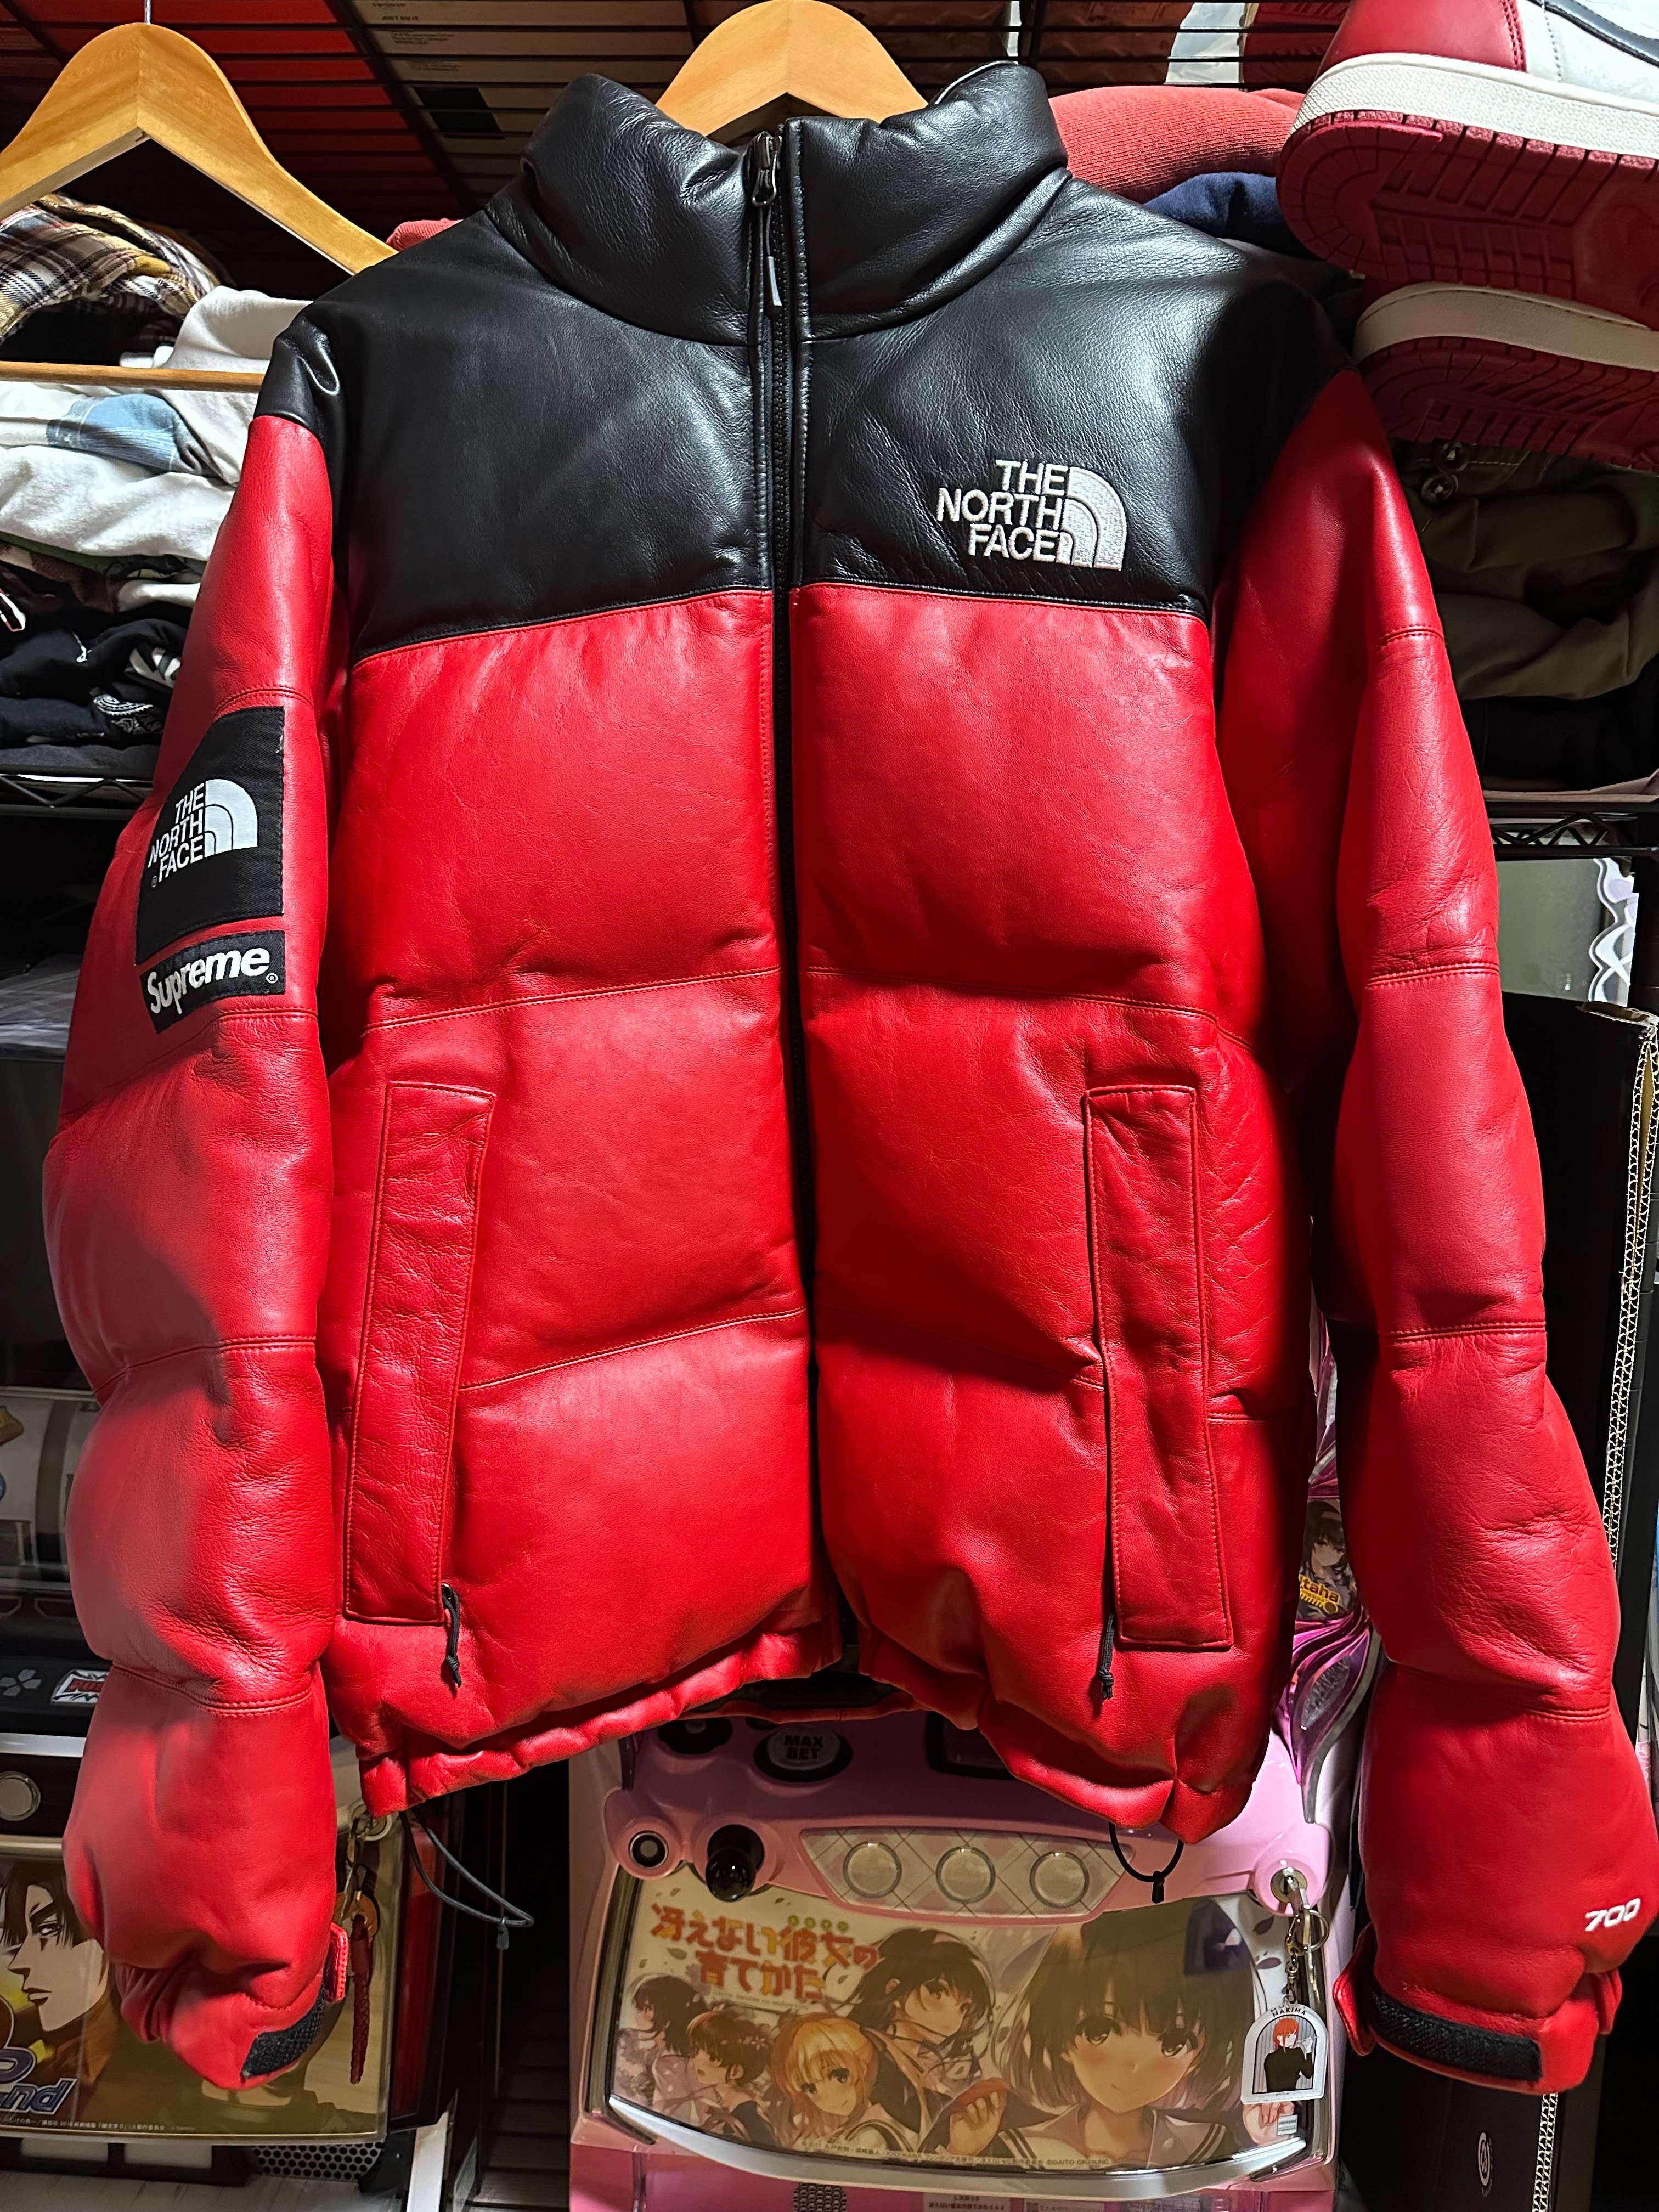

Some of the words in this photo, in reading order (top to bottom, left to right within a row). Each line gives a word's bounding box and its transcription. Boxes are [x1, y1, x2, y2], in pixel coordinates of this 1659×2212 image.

[995, 459, 1069, 495] THE
[936, 487, 1063, 531] NORTH
[968, 523, 1059, 562] FACE
[175, 782, 205, 824] THE
[147, 809, 204, 868] NORTH
[158, 834, 204, 883] FACE
[147, 947, 270, 1015] Supreme
[785, 1735, 823, 1747] MAX
[786, 1747, 820, 1759] BET
[1585, 1898, 1641, 1932] 700
[651, 1903, 878, 1971] 冴えない彼女の
[695, 1950, 824, 2002] 育てかた
[1272, 2007, 1306, 2017] MAKIMA
